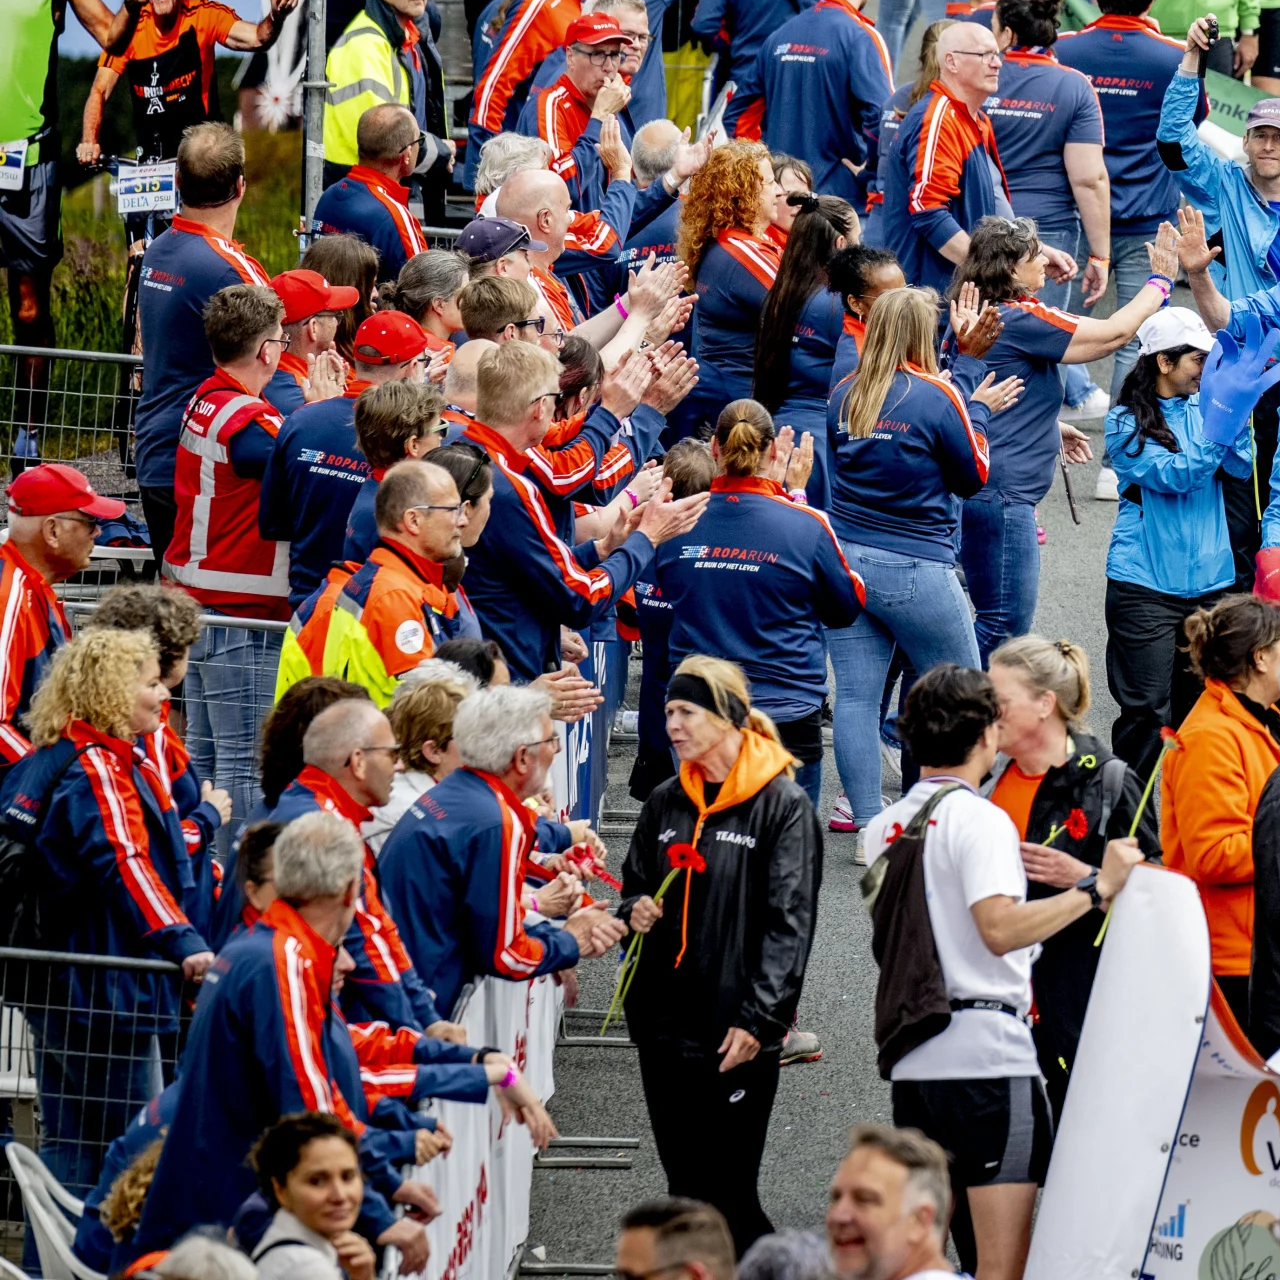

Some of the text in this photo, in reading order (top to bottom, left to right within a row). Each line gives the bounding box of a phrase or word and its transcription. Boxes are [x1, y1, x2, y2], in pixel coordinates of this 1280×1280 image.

[1096, 76, 1154, 89] ROPARUN
[1001, 98, 1057, 113] ROPARUN
[122, 195, 150, 209] DELA
[325, 454, 373, 476] ROPAR
[712, 547, 779, 564] ROPARUN
[703, 561, 717, 569] RUN
[737, 564, 760, 572] LEVEN
